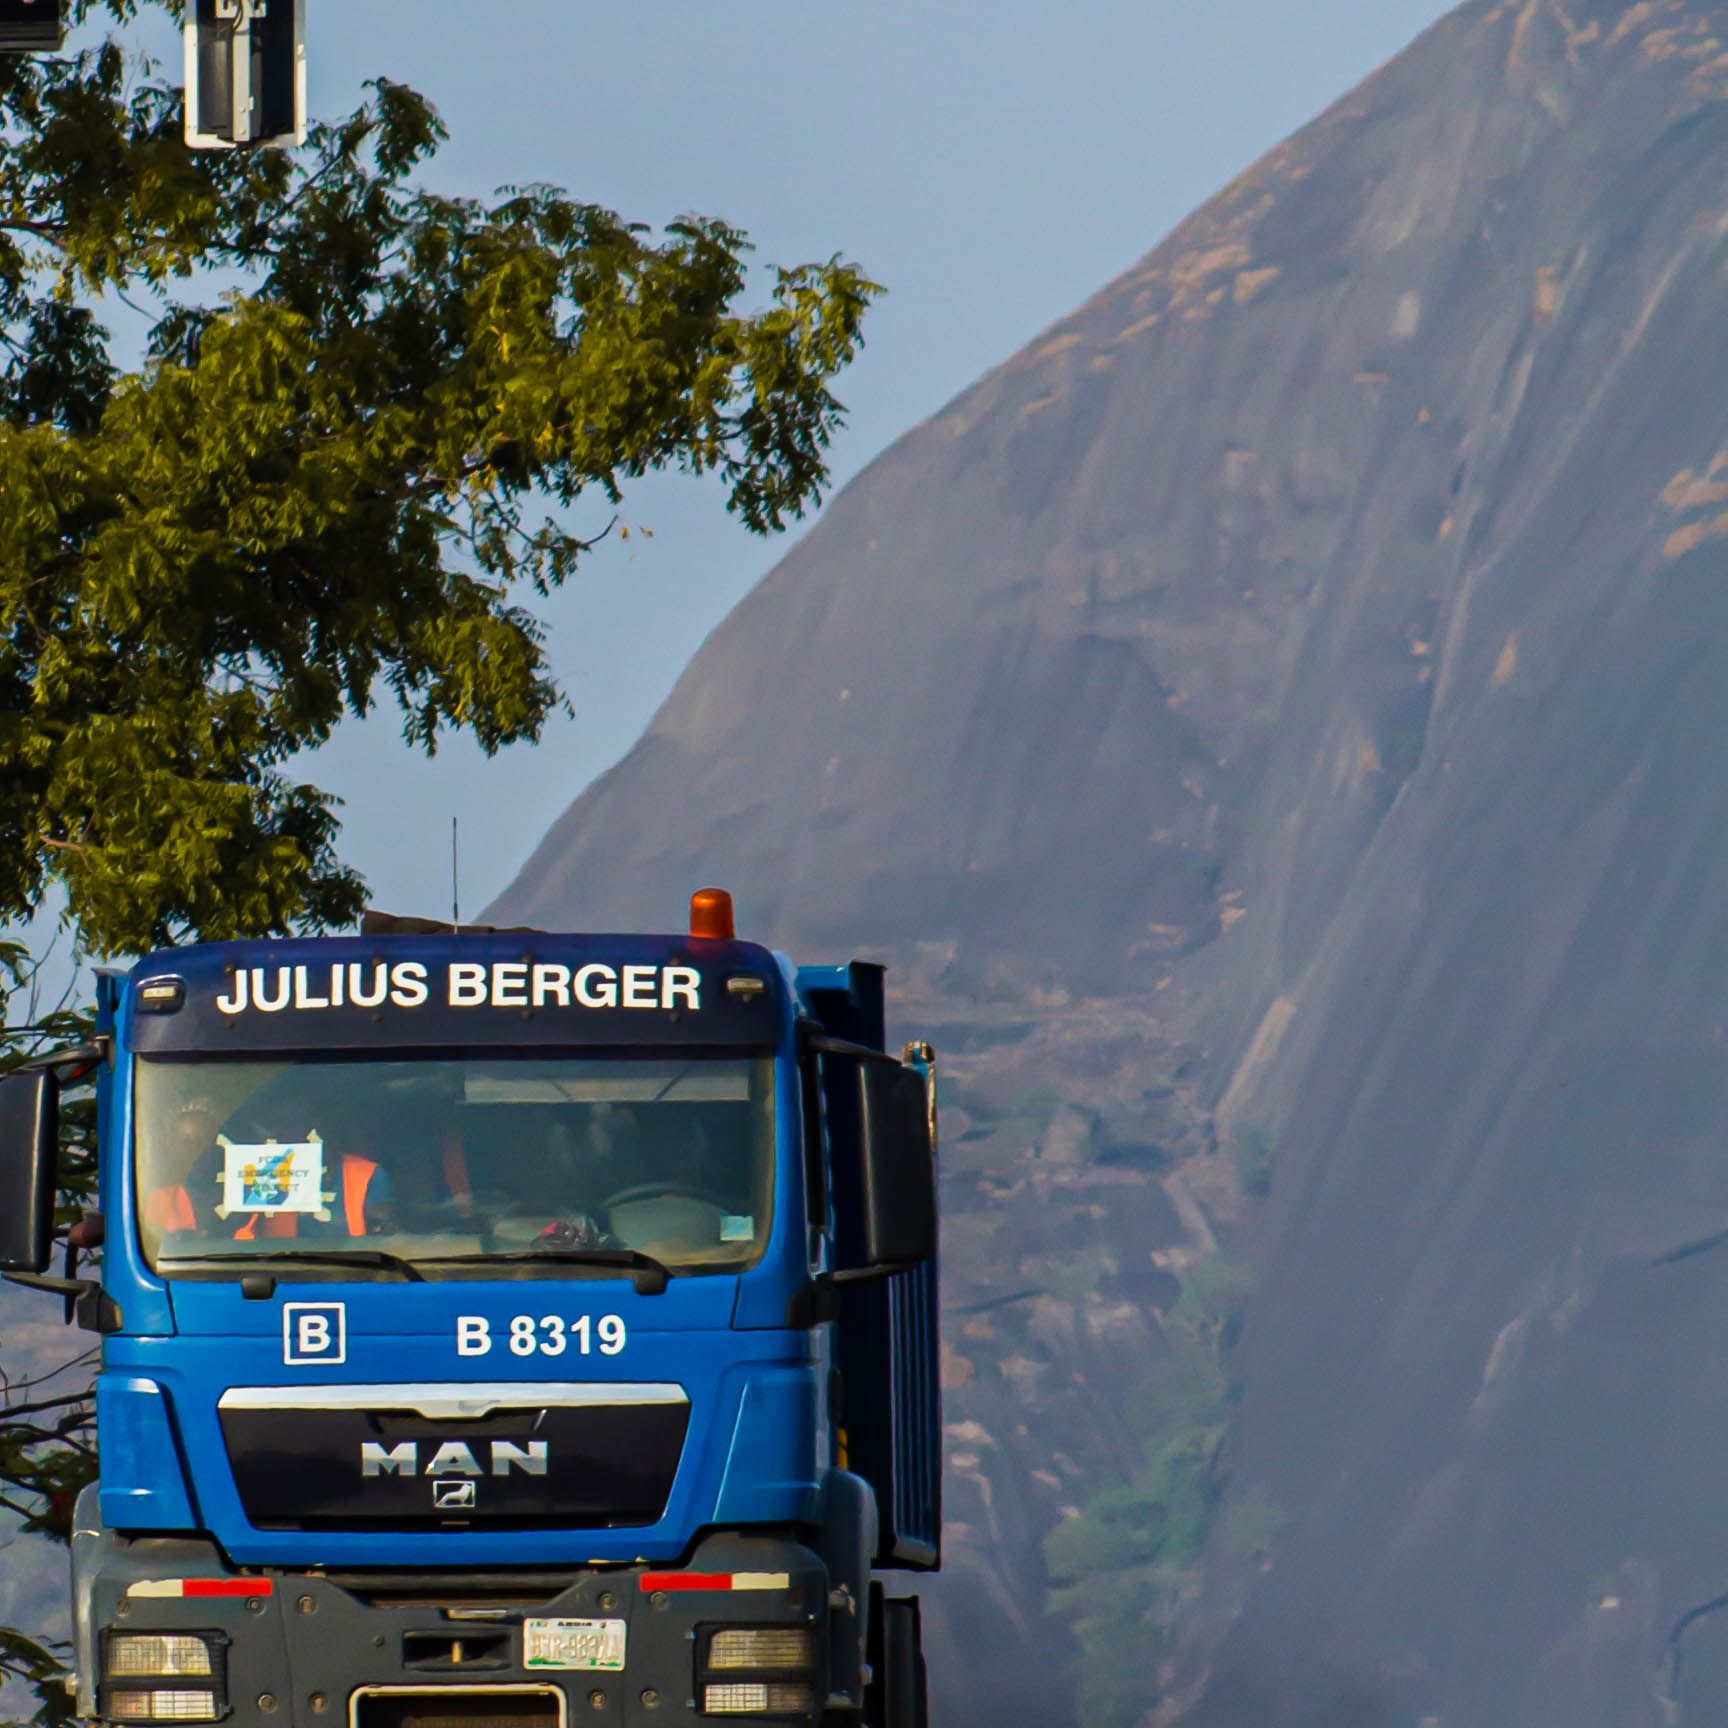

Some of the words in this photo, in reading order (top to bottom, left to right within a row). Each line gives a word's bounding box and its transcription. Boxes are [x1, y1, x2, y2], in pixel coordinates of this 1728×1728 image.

[216, 962, 428, 1014] JULIUS
[449, 963, 701, 1010] BERGER
[299, 1315, 331, 1353] B
[457, 1316, 492, 1356] B
[509, 1315, 626, 1356] 8319
[361, 1441, 548, 1476] MAN
